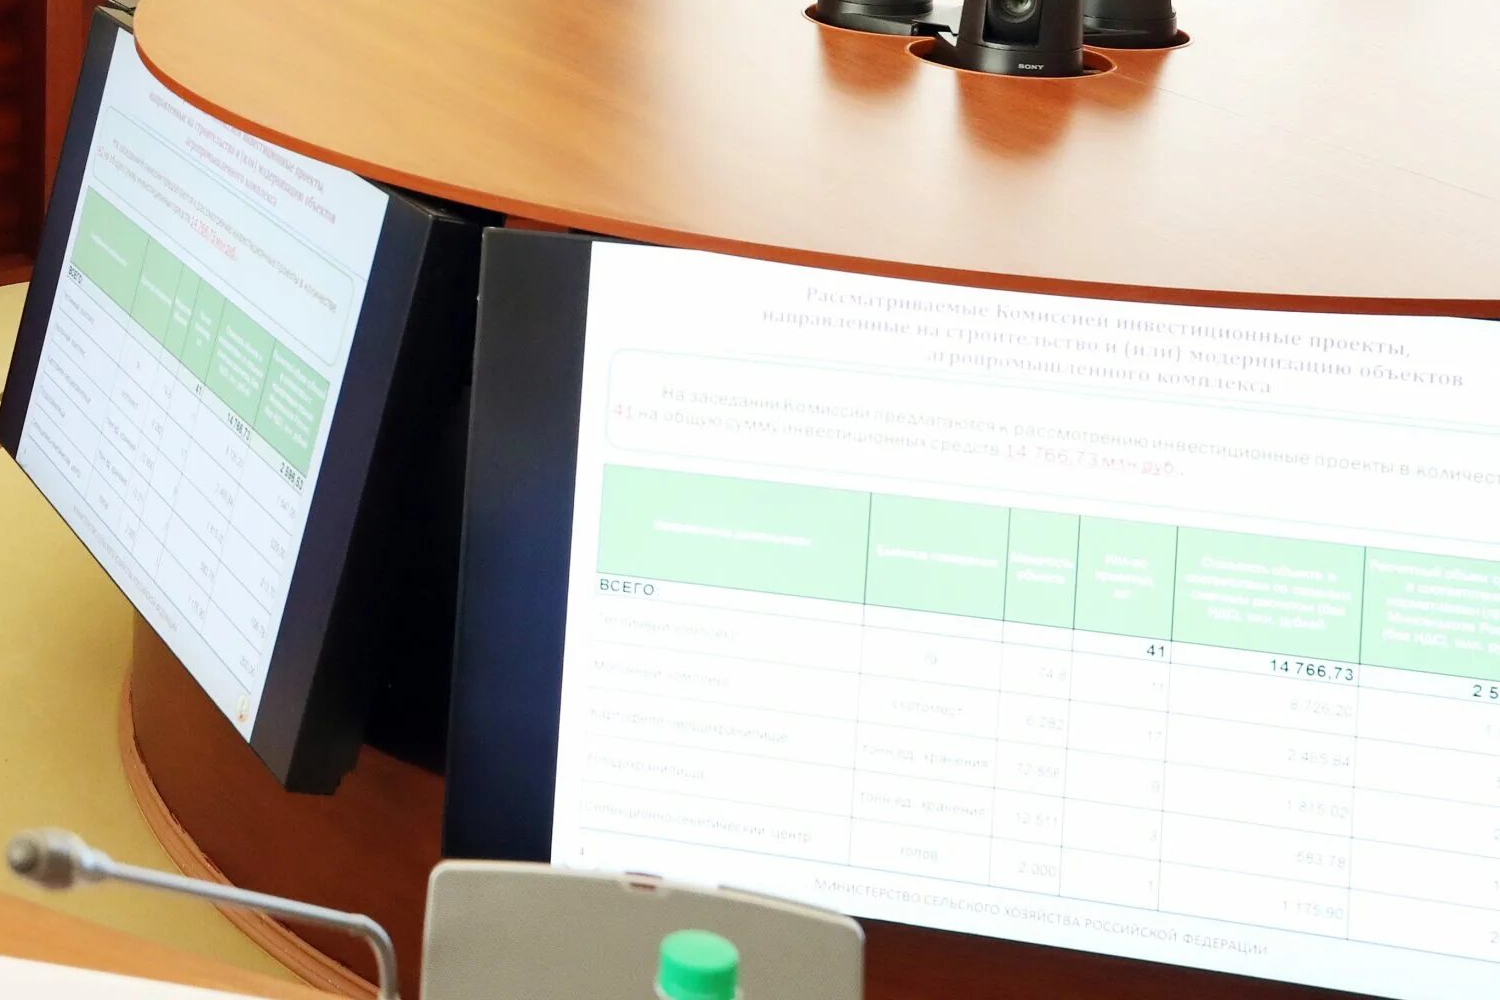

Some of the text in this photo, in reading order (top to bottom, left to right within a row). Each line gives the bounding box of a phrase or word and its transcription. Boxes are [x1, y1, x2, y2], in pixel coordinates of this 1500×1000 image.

[997, 302, 1108, 328] Комиссией
[1115, 316, 1301, 349] инвестиционные
[1307, 334, 1411, 360] проекты,
[1123, 341, 1182, 363] (или)
[1189, 349, 1352, 378] модернизацию
[1359, 362, 1465, 387] объектов
[1151, 436, 1309, 468] инвестиционные
[1314, 452, 1395, 477] проекты
[1399, 462, 1411, 476] в
[598, 577, 659, 598] ВСЕГО:
[1145, 642, 1166, 658] 41
[1268, 657, 1290, 674] 14
[1294, 660, 1355, 684] 766,73
[1471, 682, 1483, 698] 2
[814, 876, 1268, 958] МИНИСТЕРСТВО СЕЛЬСКОГО ХОЗЯЙСТВА РОССИЙСКОЙ ФЕДЕРАЦИИ
